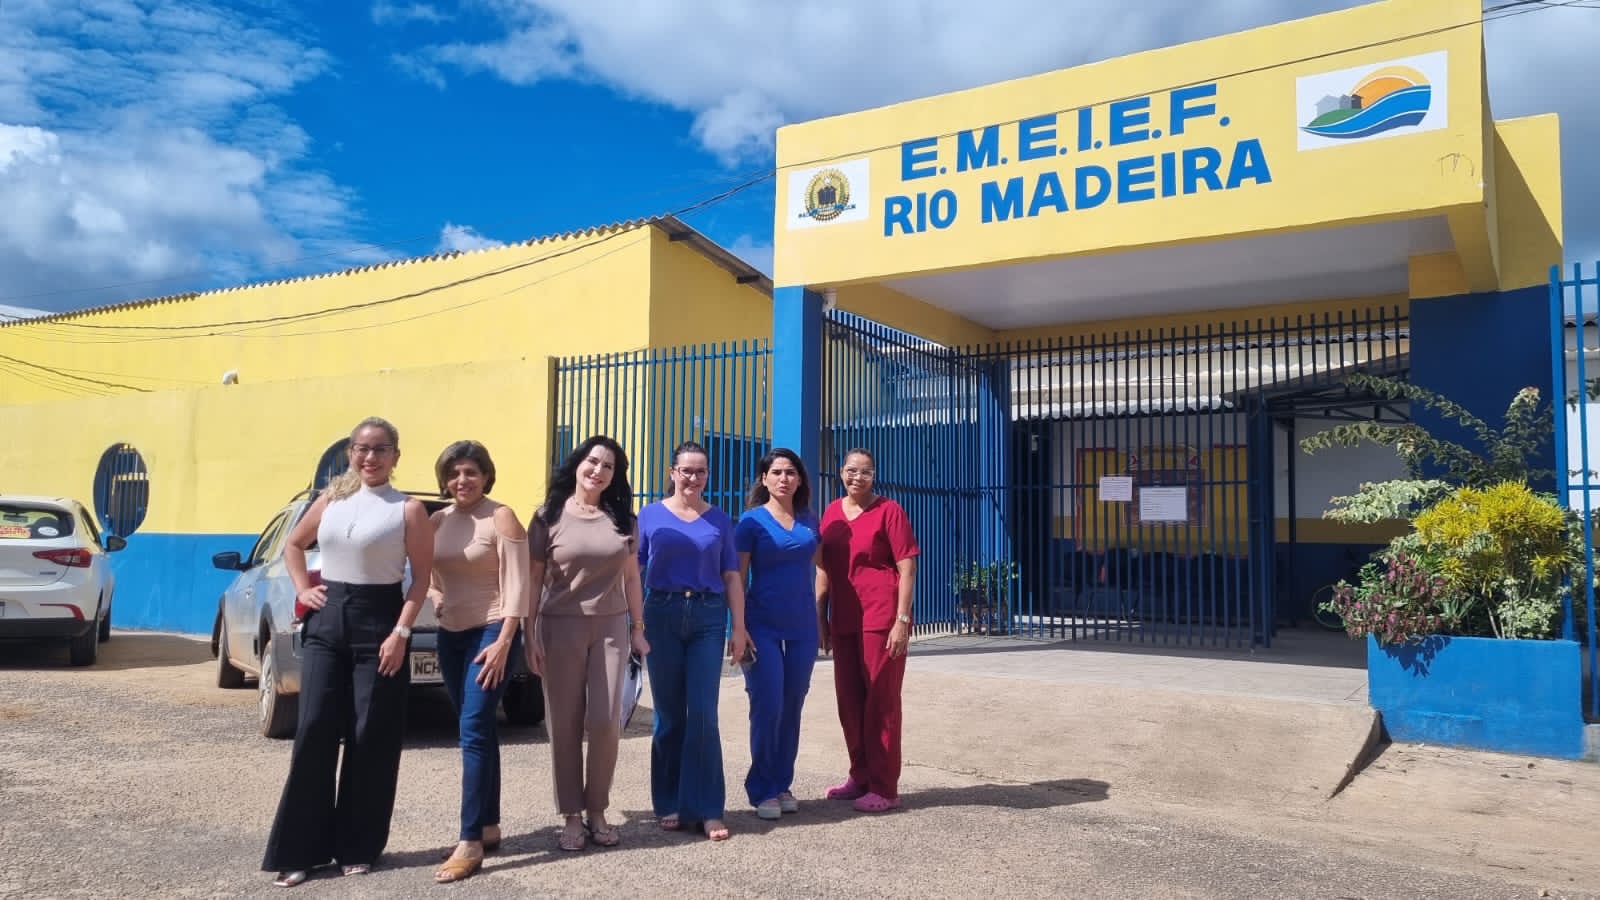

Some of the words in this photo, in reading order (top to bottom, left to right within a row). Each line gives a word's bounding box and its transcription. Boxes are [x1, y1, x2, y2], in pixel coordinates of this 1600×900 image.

[901, 83, 1230, 181] E.M.E.I.E.F.
[883, 189, 958, 237] RIO
[981, 138, 1272, 224] MADEIRA
